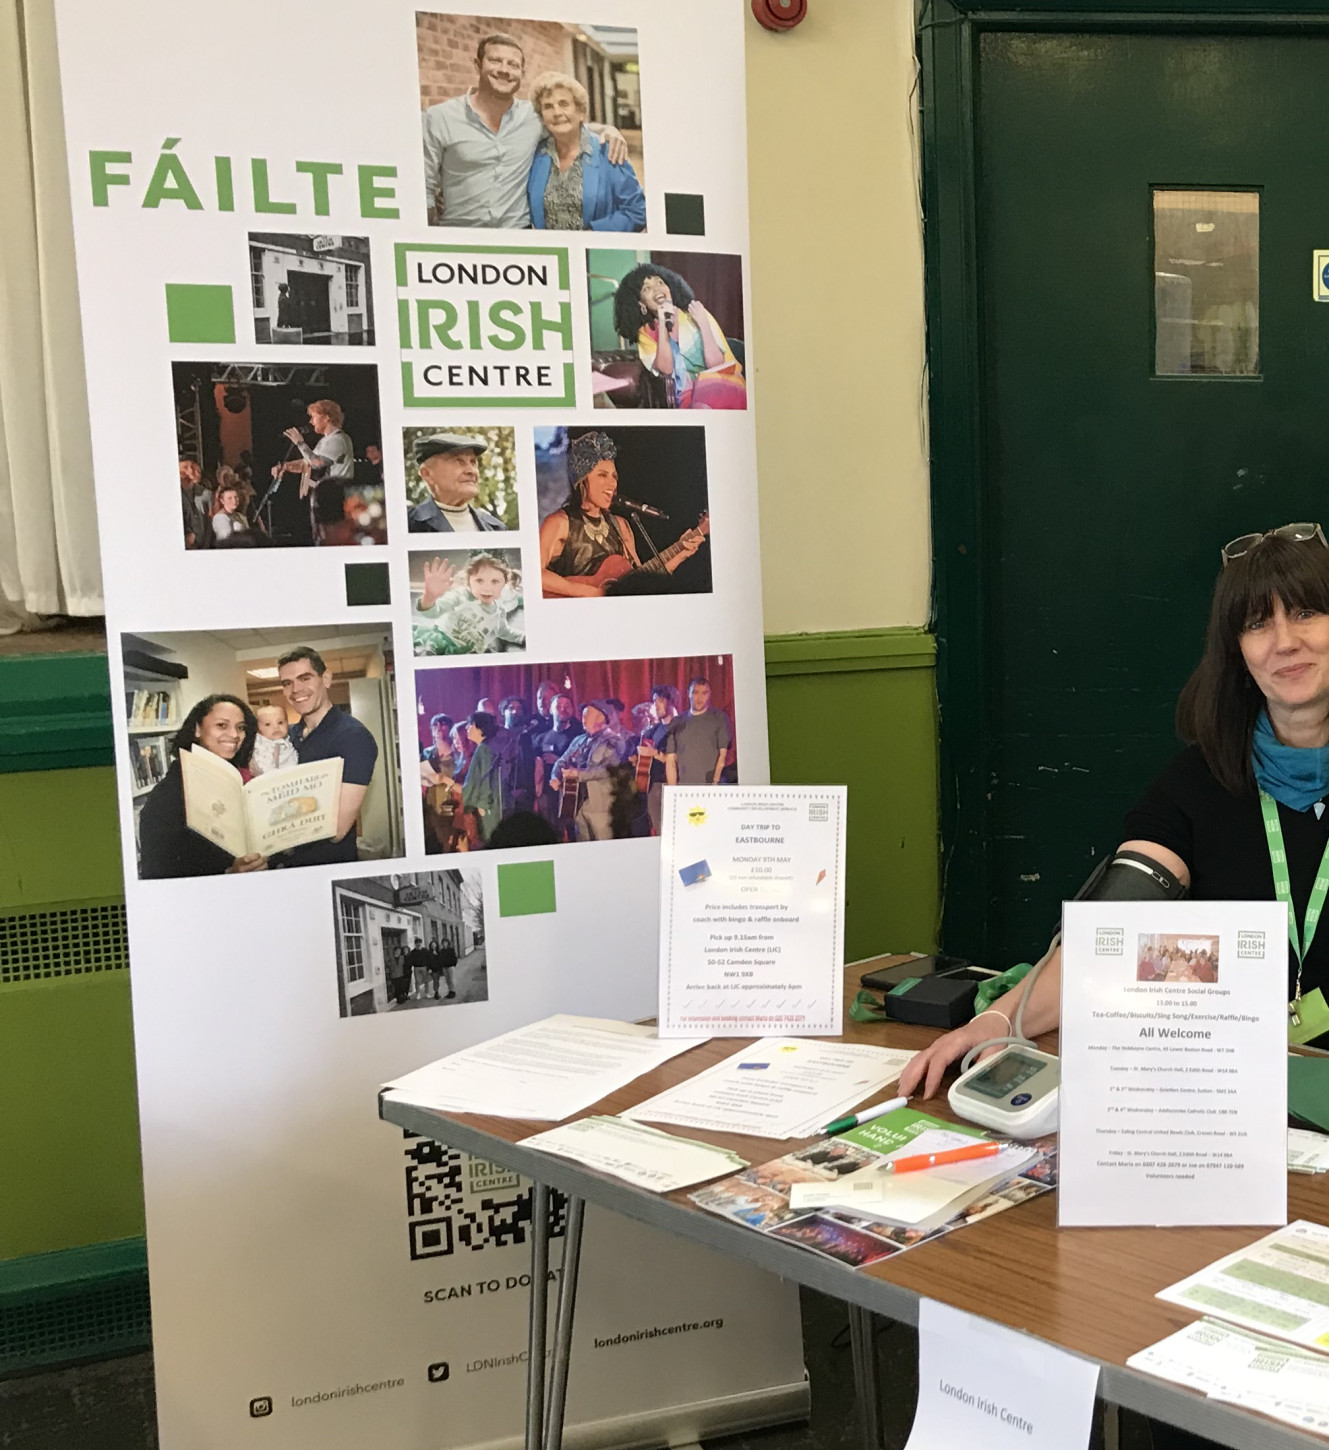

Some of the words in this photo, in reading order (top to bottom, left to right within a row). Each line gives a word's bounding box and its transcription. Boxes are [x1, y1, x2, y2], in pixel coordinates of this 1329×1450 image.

[88, 136, 401, 220] FÁILTE
[417, 261, 548, 287] LONDON
[399, 298, 573, 351] IRISH
[422, 365, 553, 388] CENTRE
[735, 836, 785, 844] EASTBOURNE
[1095, 937, 1124, 947] IRISH
[1237, 940, 1265, 950] IRISH
[1123, 986, 1148, 994] London
[1164, 987, 1186, 995] Centre
[1187, 987, 1206, 995] Social
[1207, 988, 1231, 996] Groups
[1139, 1027, 1155, 1039] All
[1158, 1027, 1212, 1040] Welcome
[475, 1176, 514, 1188] CENTRE
[423, 1282, 473, 1304] SCAN
[475, 1278, 501, 1295] TO
[594, 1316, 724, 1349] londonirishcentre.org
[291, 1377, 405, 1408] londonirishcentre
[939, 1378, 976, 1406] London
[976, 1396, 999, 1417] Irish
[1000, 1407, 1034, 1435] Centre
